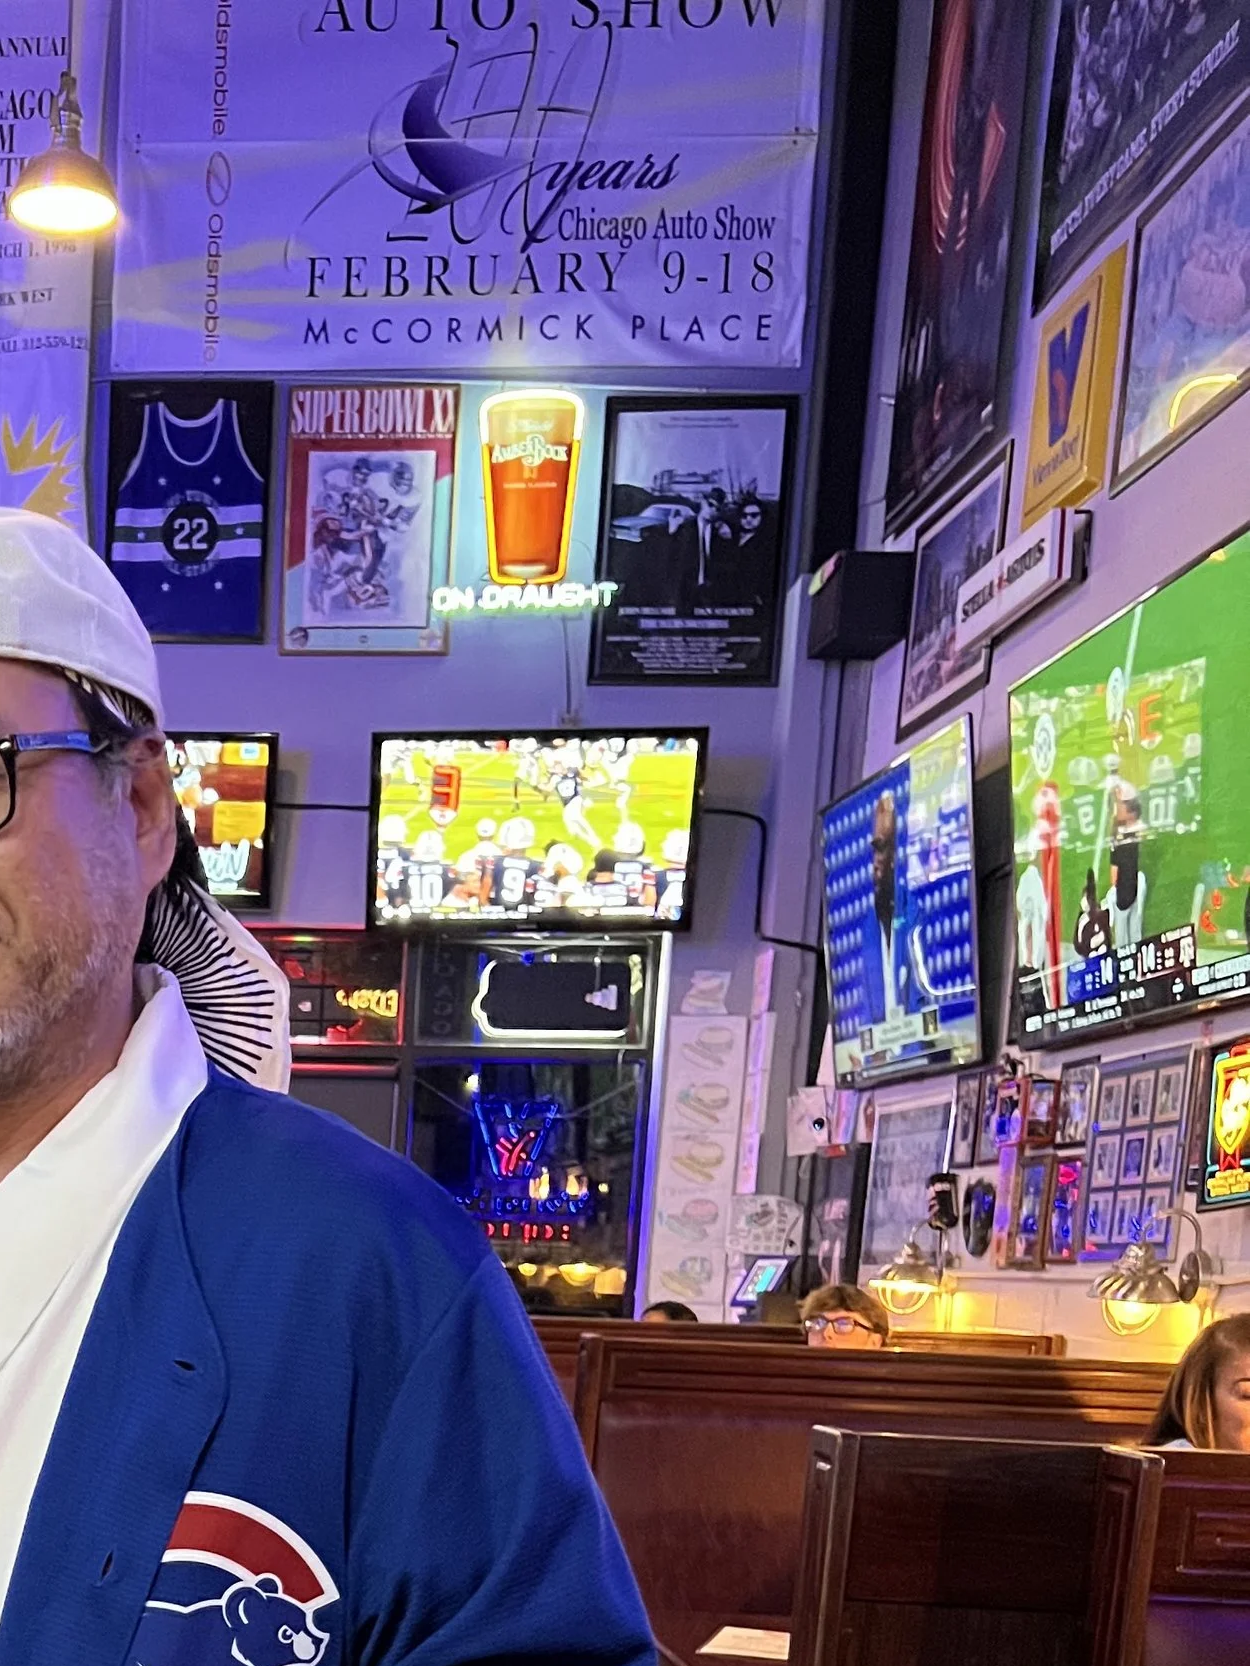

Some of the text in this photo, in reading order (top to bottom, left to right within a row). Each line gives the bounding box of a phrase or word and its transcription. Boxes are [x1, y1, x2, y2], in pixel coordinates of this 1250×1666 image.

[572, 0, 783, 29] SHOW
[213, 0, 232, 136] ldsmobile
[558, 205, 776, 248] Chicago Auto Show
[204, 213, 224, 363] Oldsmobile
[306, 251, 775, 298] FEBRUARY 9-18
[21, 287, 55, 303] WEST
[304, 314, 773, 344] McCORMICK PLACE
[291, 391, 362, 433] SUPER
[363, 391, 427, 433] BOWL
[173, 518, 209, 549] 22
[432, 580, 618, 612] ON DRAUGHT
